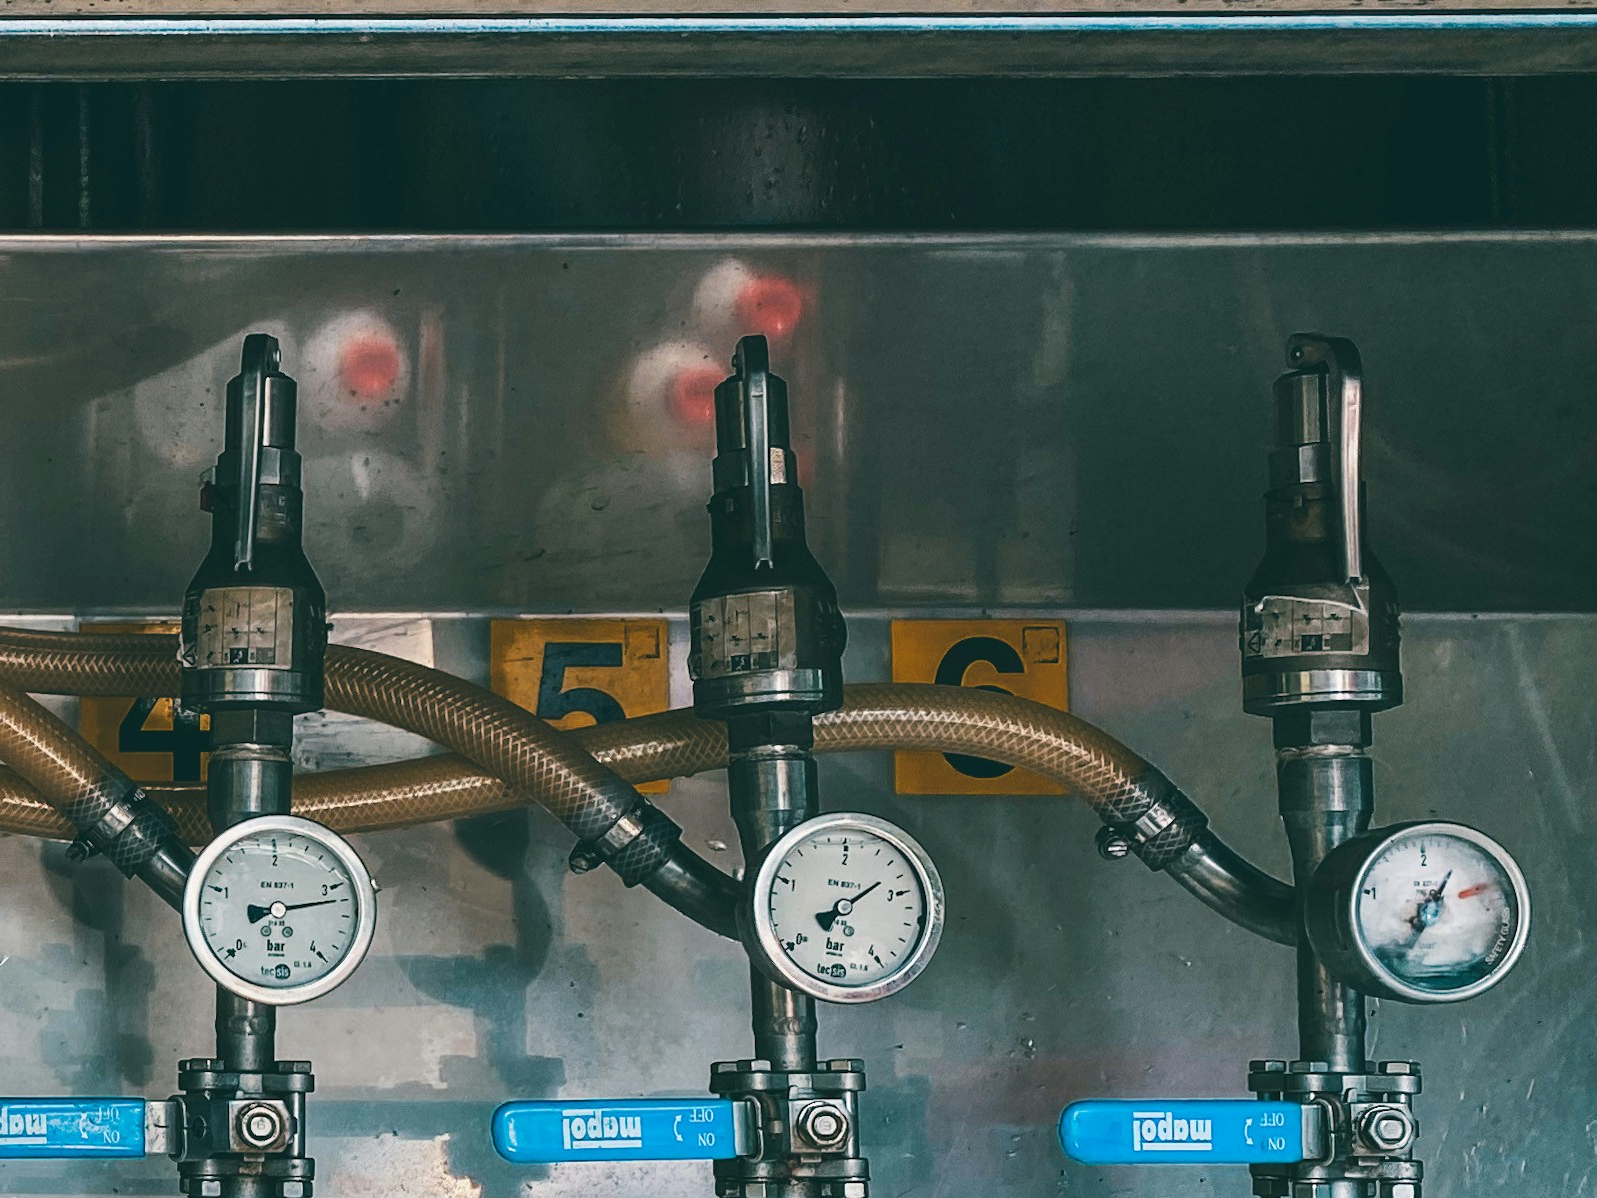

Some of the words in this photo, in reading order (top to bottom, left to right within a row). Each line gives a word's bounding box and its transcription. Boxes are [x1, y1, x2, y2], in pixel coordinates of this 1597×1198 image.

[536, 642, 626, 725] 5
[119, 699, 214, 782] 4
[272, 855, 278, 867] 2
[841, 854, 848, 866] 2
[1421, 854, 1427, 867] 2
[322, 884, 328, 896] 3
[791, 880, 796, 892] 1
[224, 887, 229, 899] 1
[887, 890, 894, 902] 3
[1370, 888, 1376, 900] 1
[236, 939, 242, 950] 0
[267, 939, 285, 951] bar
[796, 933, 802, 945] 0
[826, 937, 844, 951] bar
[310, 940, 316, 952] 4
[868, 944, 874, 956] 4
[1485, 934, 1507, 966] SAFETY
[689, 1109, 713, 1123] OFF
[1260, 1113, 1284, 1127] OFF
[562, 1110, 642, 1149] mapol
[1133, 1112, 1212, 1151] mapol
[698, 1133, 715, 1146] ON
[1268, 1137, 1285, 1150] ON
